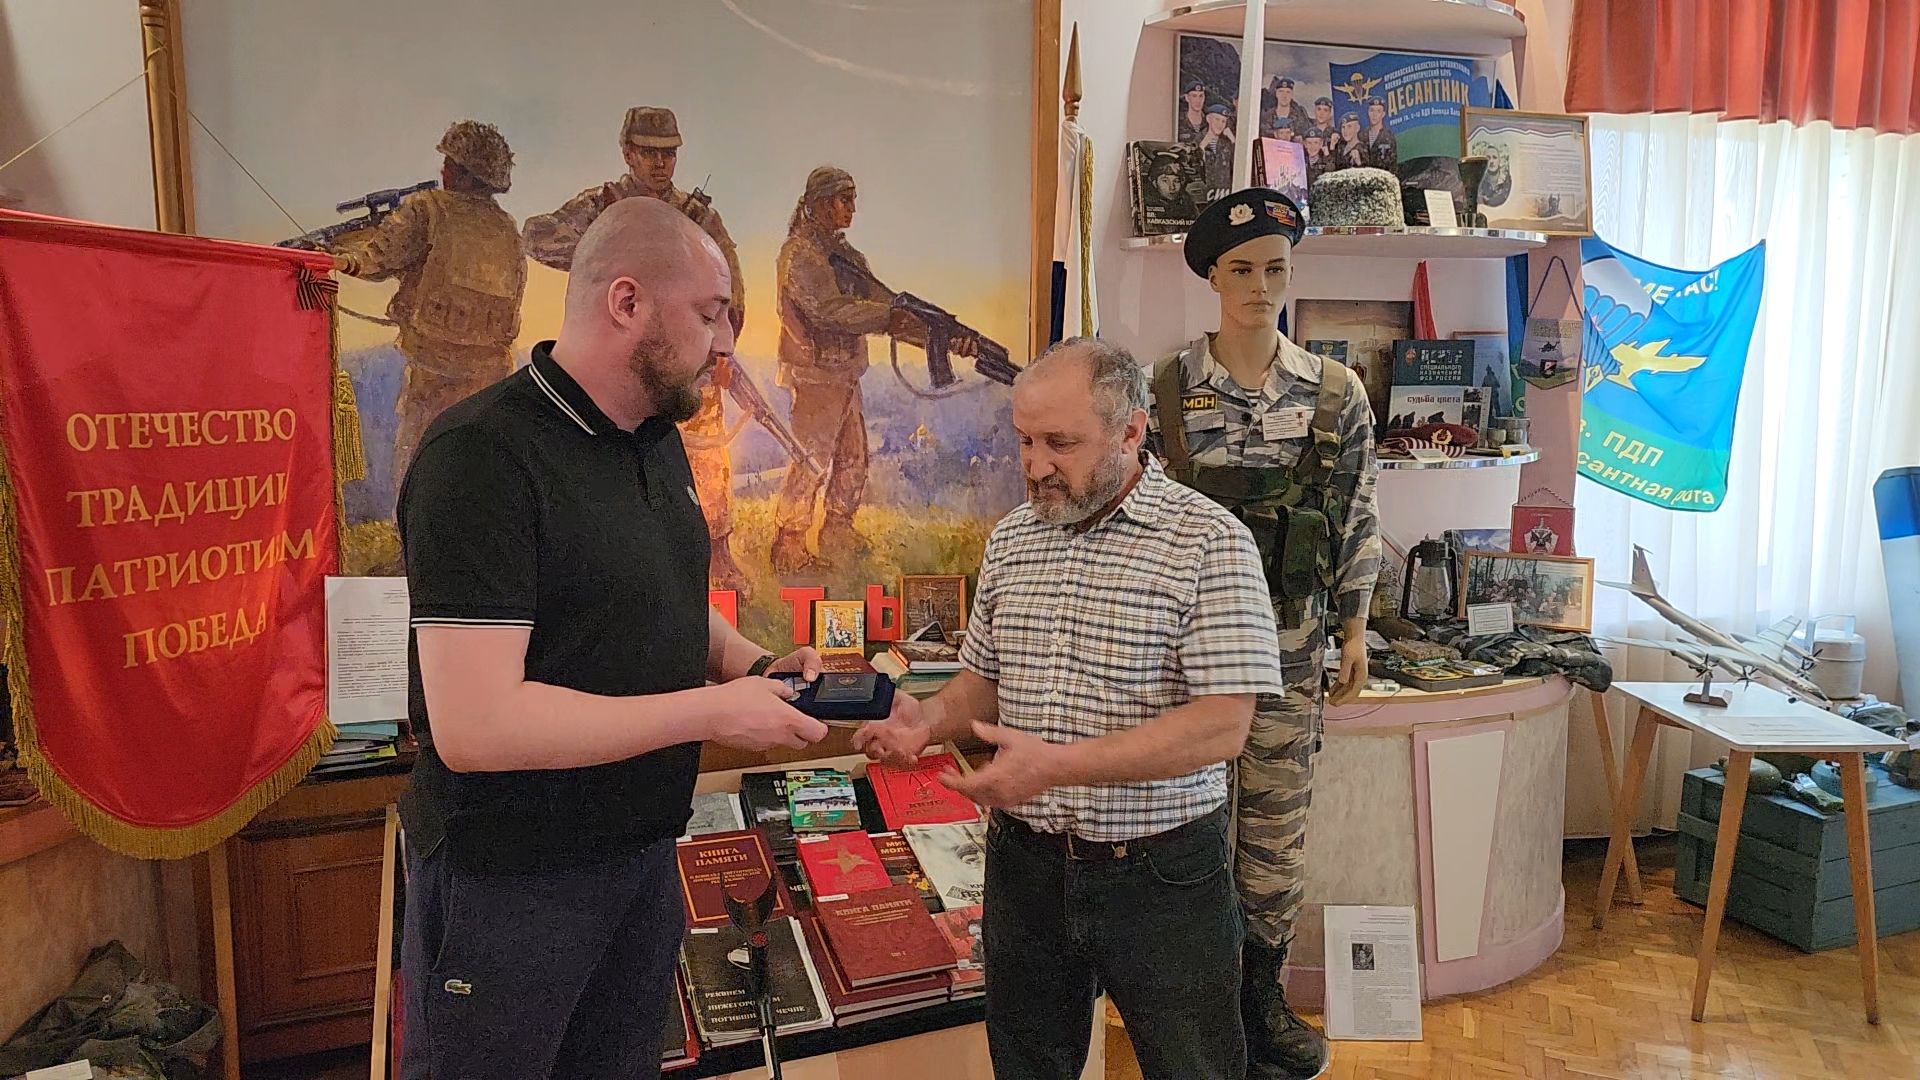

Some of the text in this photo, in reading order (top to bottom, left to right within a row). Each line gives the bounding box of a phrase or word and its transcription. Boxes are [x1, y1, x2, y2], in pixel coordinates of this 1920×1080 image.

[1387, 79, 1469, 117] ДЕСАНТНИК
[1146, 218, 1184, 226] КАВКАЗСКИЙ
[1676, 269, 1720, 298] АС!
[65, 408, 297, 452] ОТЕЧЕСТВО
[1602, 431, 1664, 467] ПДП
[1577, 452, 1715, 505] сантная рота
[66, 472, 290, 528] ТРАДИЦИИ
[45, 528, 317, 607] ПАТРИОТИМ
[122, 602, 268, 669] ПОБЕДА
[695, 853, 748, 867] ПАМЯТИ
[699, 847, 740, 858] КНИГА
[835, 905, 870, 917] КНИГА
[870, 899, 913, 911] ПАМЯТИ
[705, 989, 746, 999] РЕКВИЕМ
[708, 996, 780, 1011] НИЖЕГОРОМ
[711, 1005, 806, 1023] ПОГИБШИ ЧЕЧНЕ
